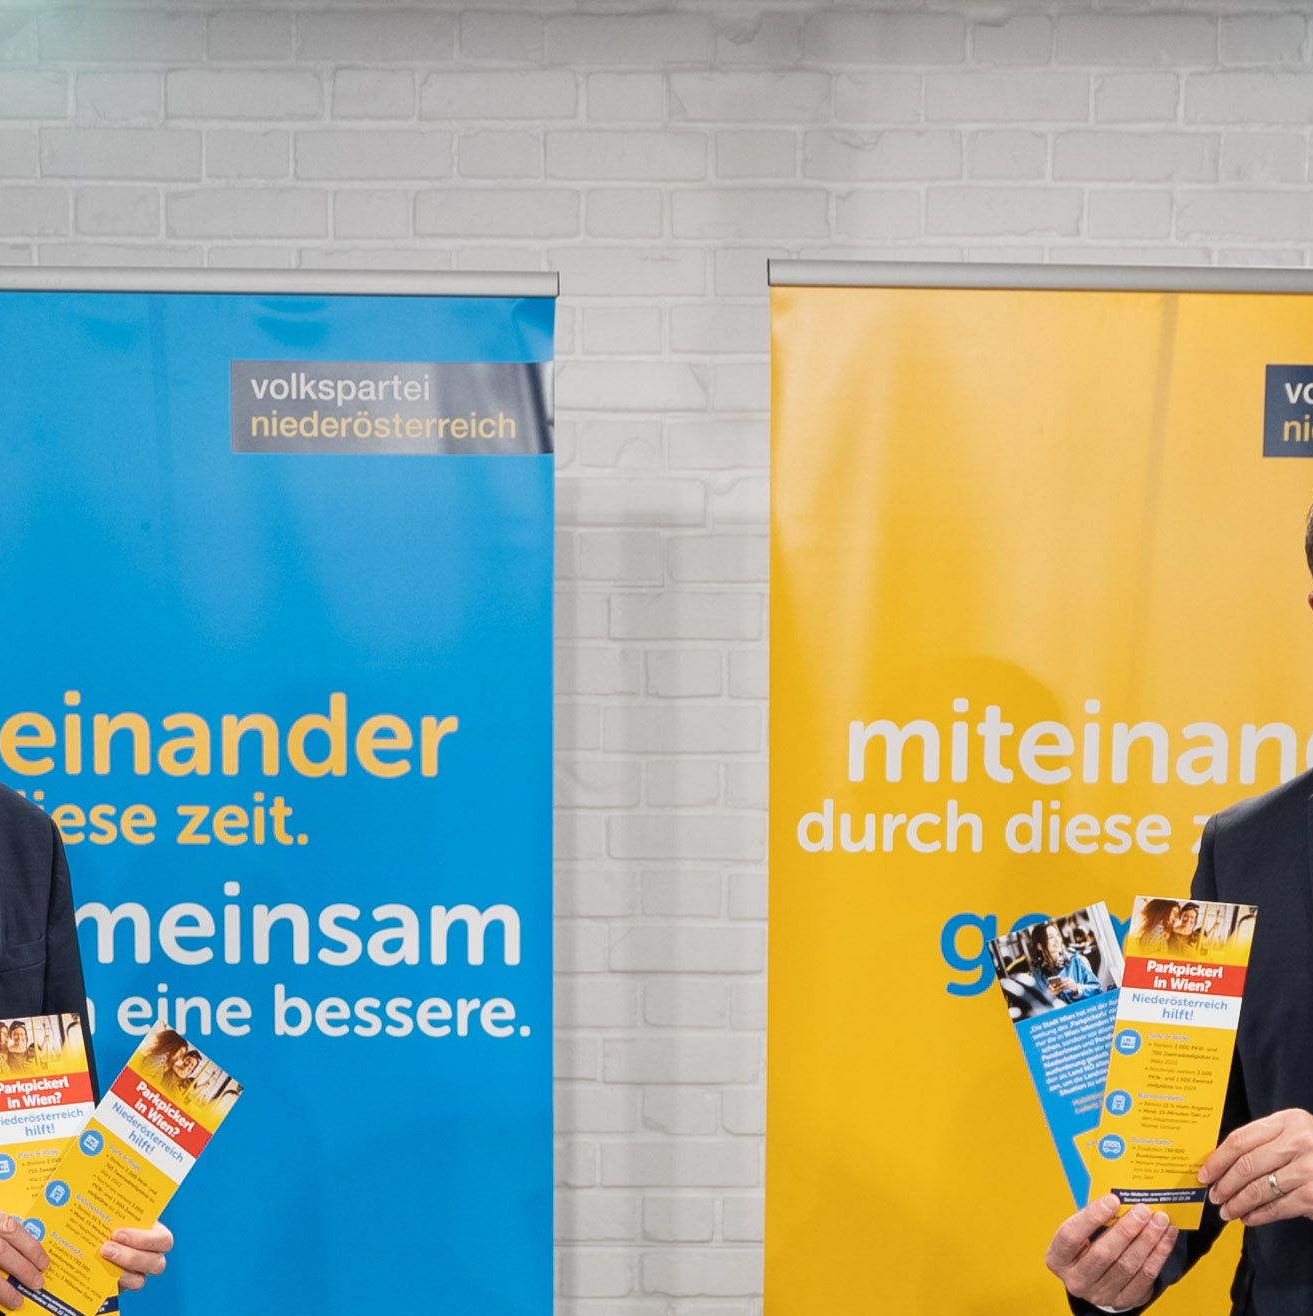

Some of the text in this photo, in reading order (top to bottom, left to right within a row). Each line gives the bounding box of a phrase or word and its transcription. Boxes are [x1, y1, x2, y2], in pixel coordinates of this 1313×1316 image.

[250, 372, 430, 407] volkspartei
[250, 410, 517, 440] niederösterreich
[176, 791, 309, 846] zeit.
[797, 798, 983, 854] durch
[1005, 799, 1171, 855] diese
[1147, 960, 1223, 978] Parkpickerl
[1153, 976, 1212, 993] in Wien?
[117, 983, 252, 1037] eine
[274, 983, 532, 1038] bessere.
[1131, 993, 1228, 1010] Niederösterreich
[1162, 1008, 1194, 1020] hilft!
[7, 1092, 62, 1109] in Wien?
[136, 1081, 195, 1132] Parkpickerl
[25, 1124, 55, 1136] hilft!
[112, 1102, 183, 1162] Niederösterreich
[134, 1098, 181, 1138] in Wien?
[129, 1130, 155, 1154] hilft!
